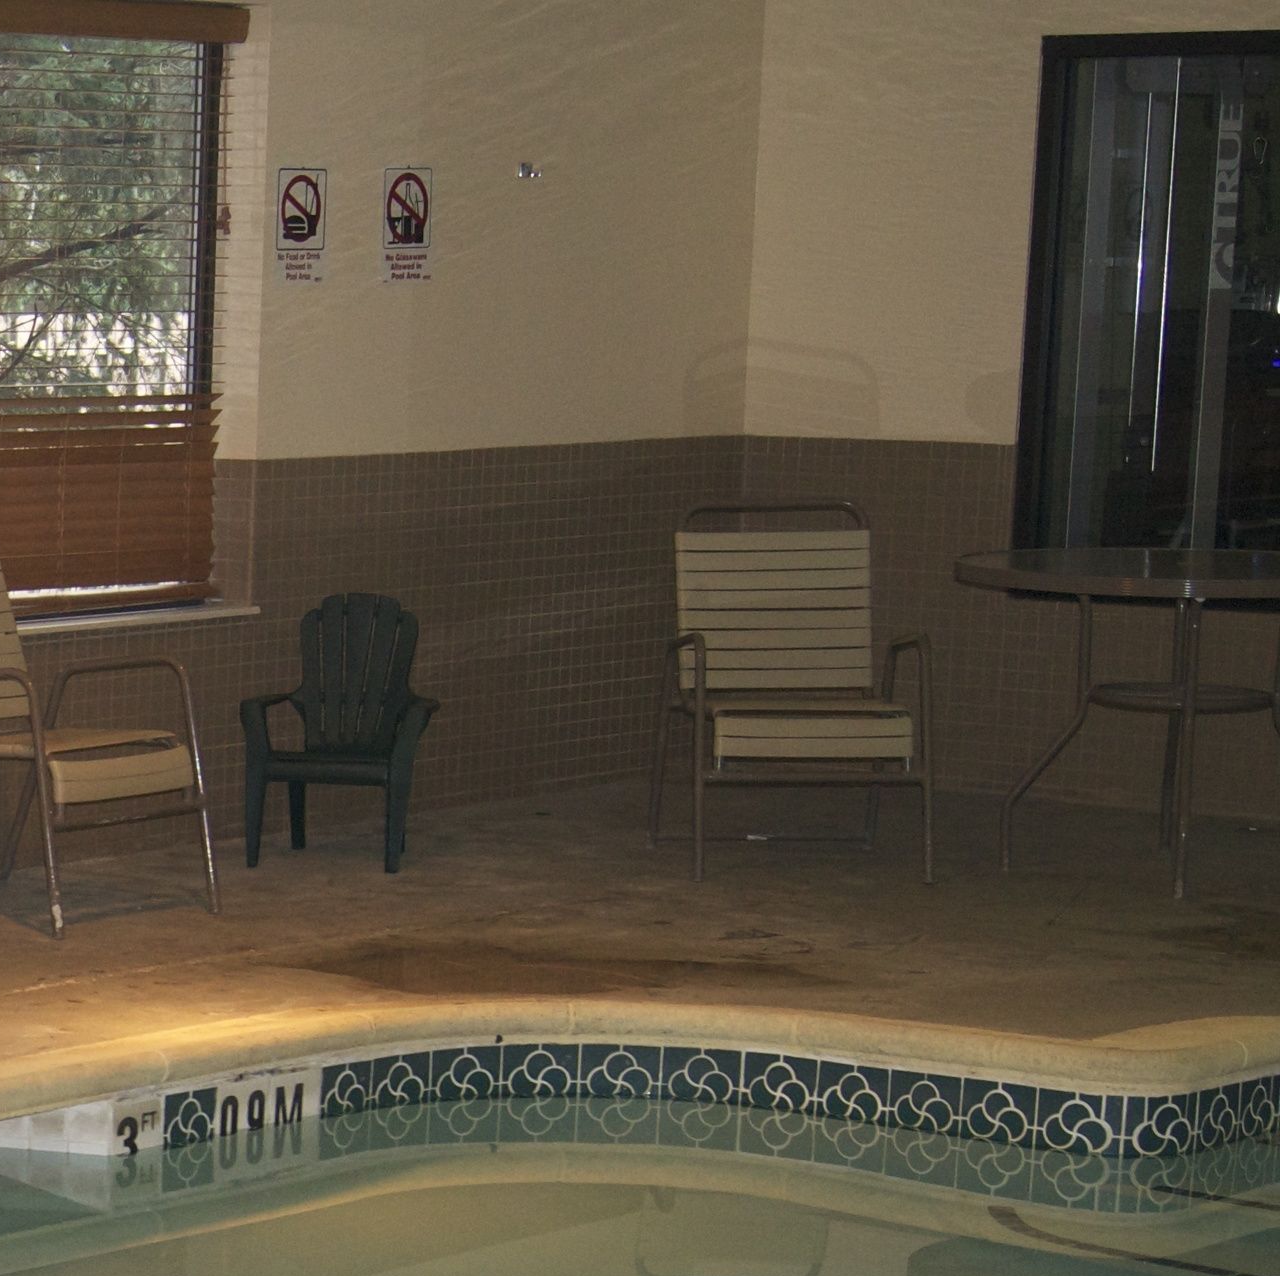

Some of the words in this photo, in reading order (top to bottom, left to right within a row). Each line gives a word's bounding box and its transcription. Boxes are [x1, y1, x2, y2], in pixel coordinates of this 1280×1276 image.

[1212, 103, 1244, 241] TRUE
[277, 253, 285, 261] No
[285, 253, 299, 261] Food
[306, 252, 321, 260] Drink
[385, 253, 394, 261] No
[395, 252, 427, 261] Glassware
[285, 262, 306, 270] Allowed
[306, 262, 312, 270] in
[390, 262, 415, 270] Allowed
[285, 272, 298, 281] Pool
[298, 272, 311, 280] Area
[391, 271, 405, 280] Pool
[406, 271, 421, 279] Area
[116, 1116, 139, 1156] 3
[141, 1110, 158, 1132] FT
